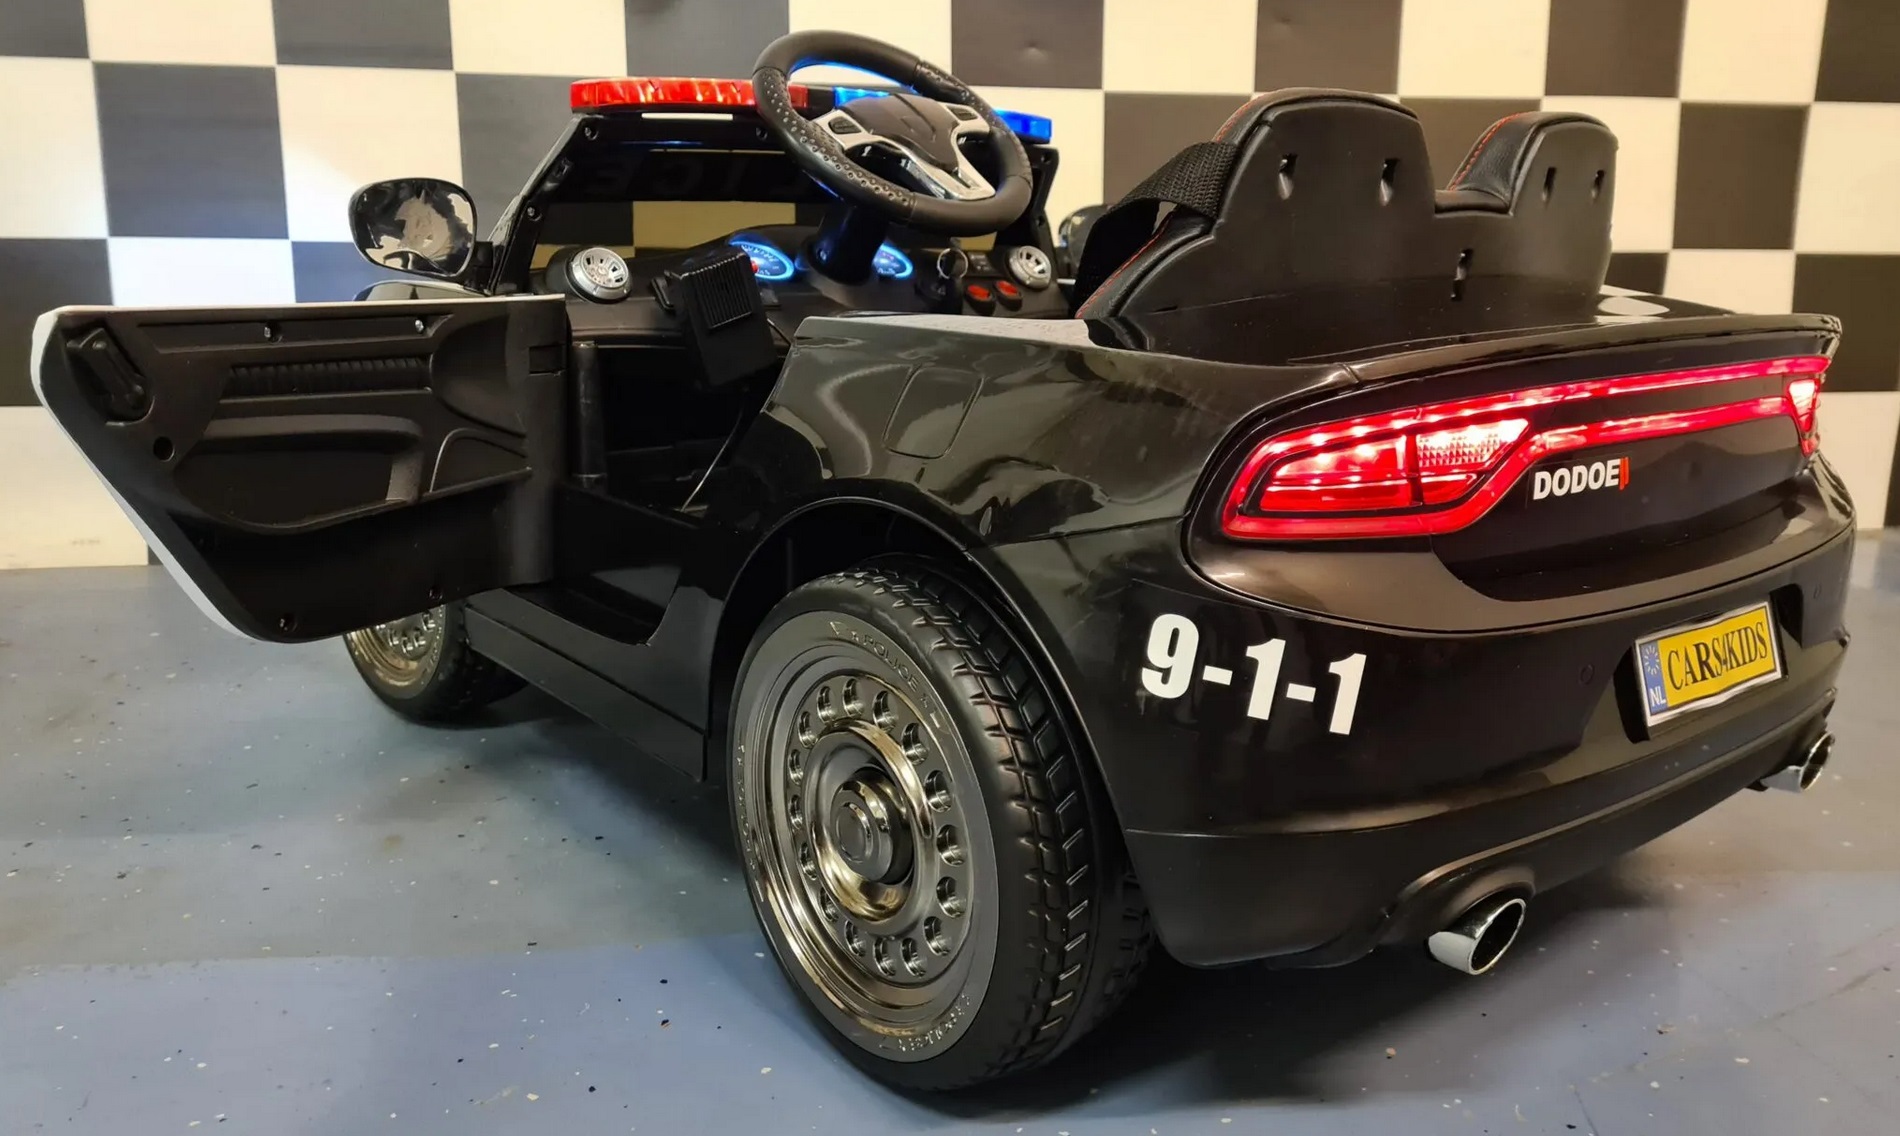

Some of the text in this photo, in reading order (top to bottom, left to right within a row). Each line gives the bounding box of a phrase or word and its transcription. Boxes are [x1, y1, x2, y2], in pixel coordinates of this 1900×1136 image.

[1141, 613, 1367, 736] 9-1-1
[1667, 621, 1768, 691] CARS4KIDS
[1649, 685, 1667, 708] NL
